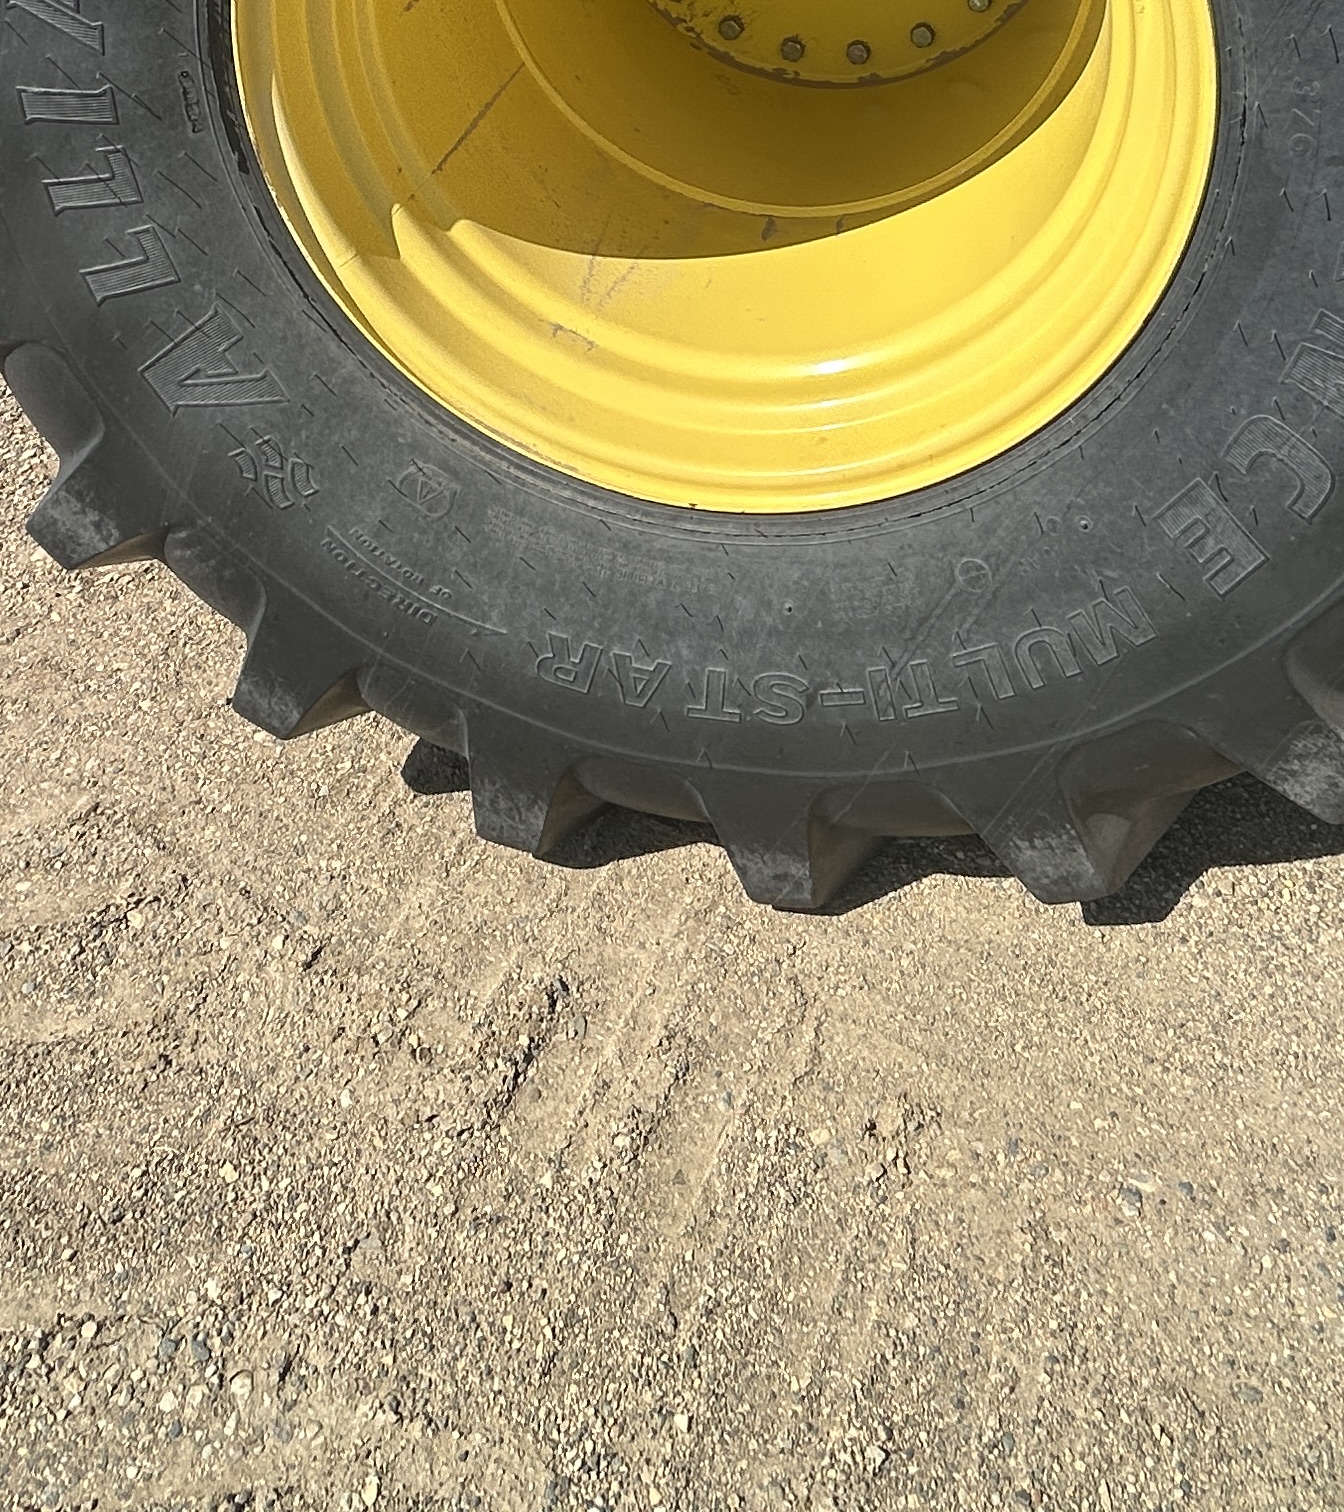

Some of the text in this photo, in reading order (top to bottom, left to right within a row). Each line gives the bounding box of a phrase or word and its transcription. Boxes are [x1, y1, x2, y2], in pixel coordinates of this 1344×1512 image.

[320, 536, 438, 626] DIRECTION
[349, 526, 454, 601] OF ROTATION
[535, 586, 1156, 726] MULTI-STAR
